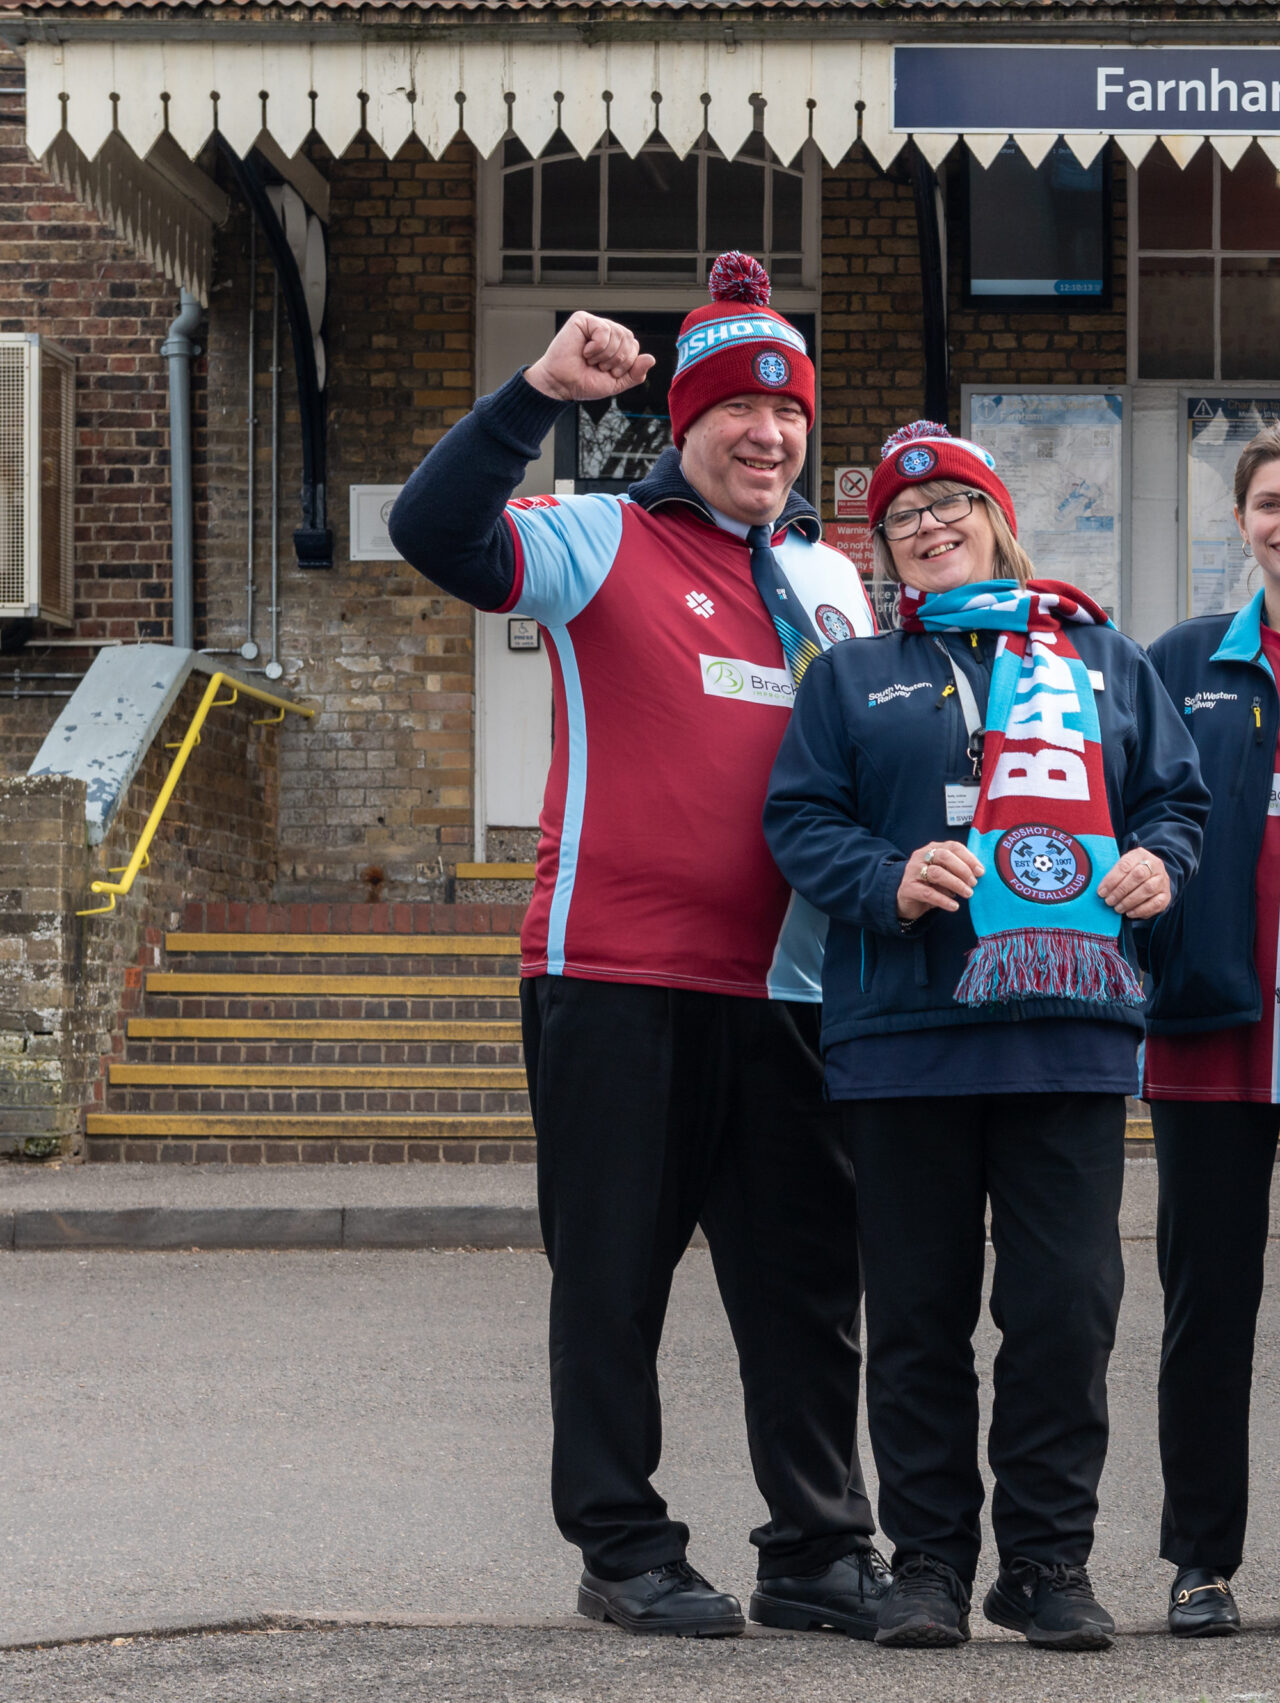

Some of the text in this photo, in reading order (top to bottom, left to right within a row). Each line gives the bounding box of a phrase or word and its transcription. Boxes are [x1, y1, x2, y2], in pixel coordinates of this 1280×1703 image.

[868, 682, 933, 701] South Western
[877, 690, 911, 705] Railway
[1203, 691, 1238, 701] Western
[1002, 826, 1073, 849] BADSHOT LEA
[1055, 858, 1072, 866] 1907
[1010, 874, 1086, 900] FOOTBALL CLUB
